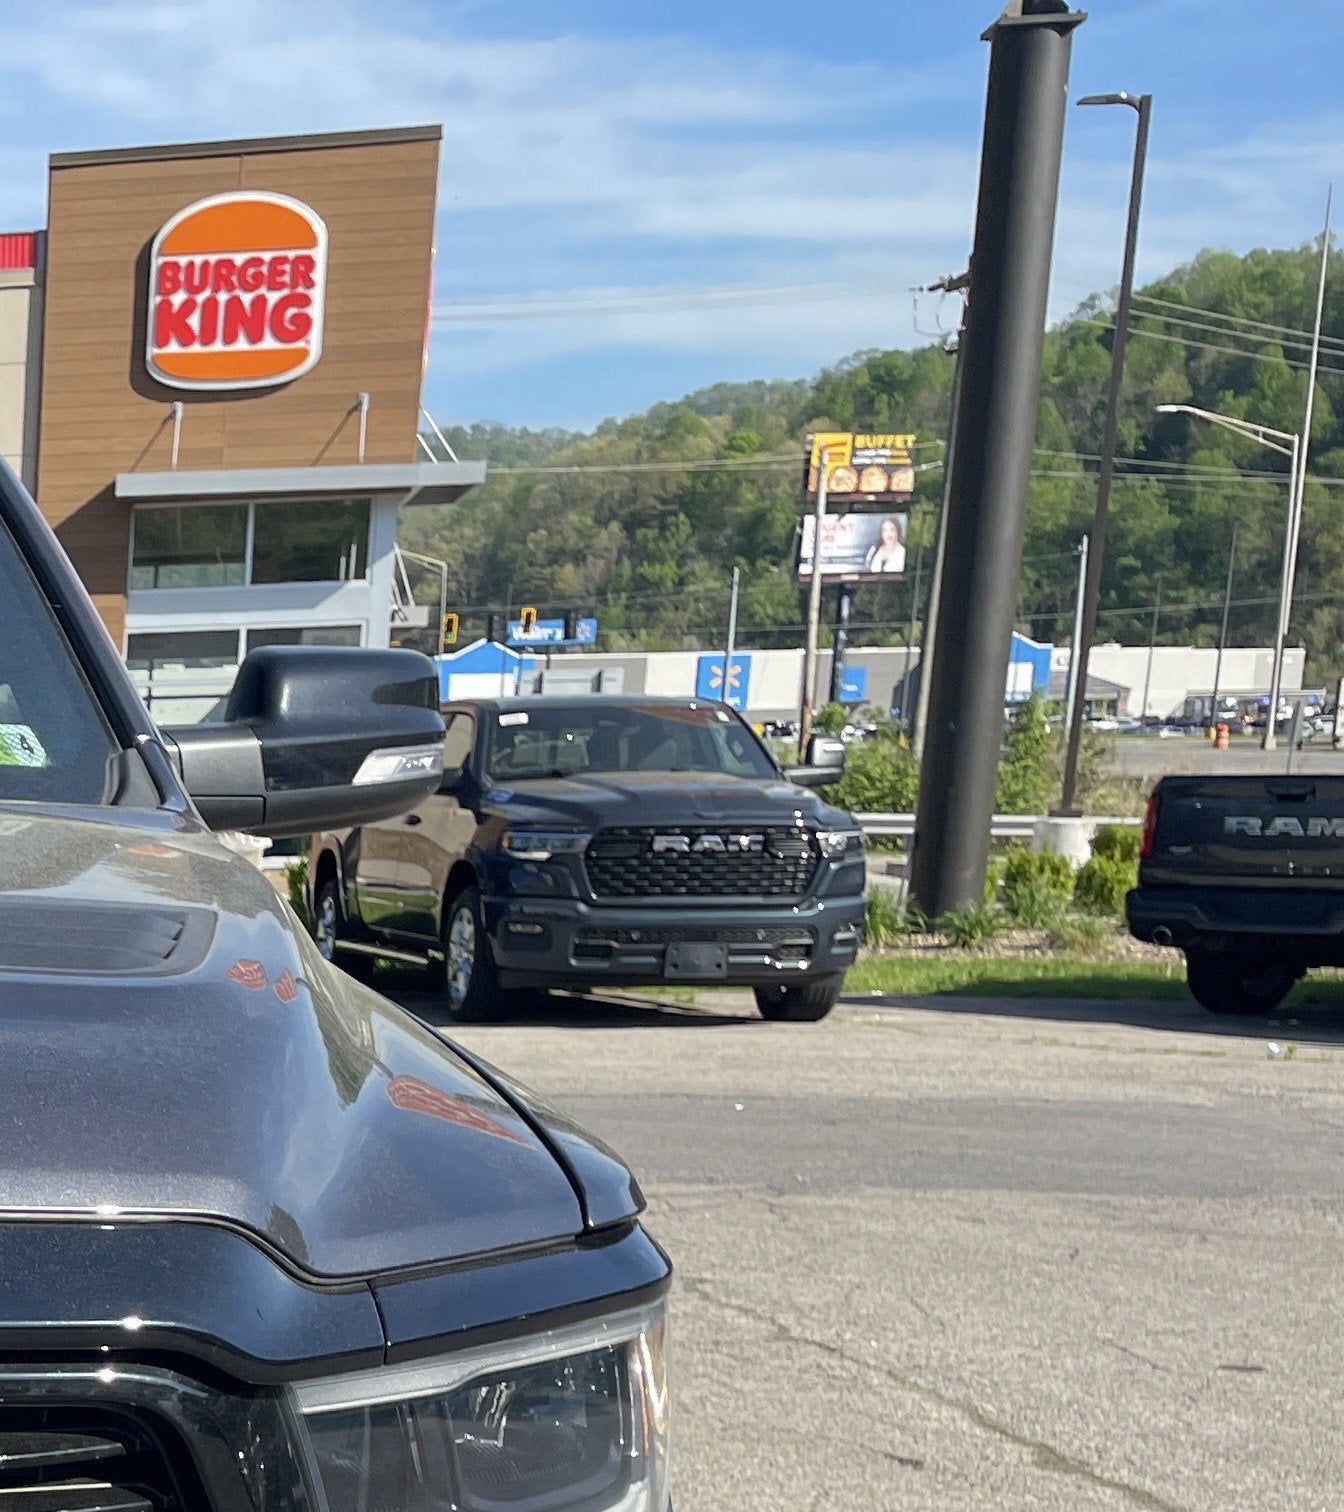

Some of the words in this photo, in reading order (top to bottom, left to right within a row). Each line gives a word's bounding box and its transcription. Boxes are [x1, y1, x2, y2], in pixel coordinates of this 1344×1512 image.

[156, 254, 317, 297] BURGER
[153, 293, 314, 349] KING
[16, 732, 36, 756] 4
[1223, 816, 1344, 837] RAM
[652, 834, 765, 852] RAM
